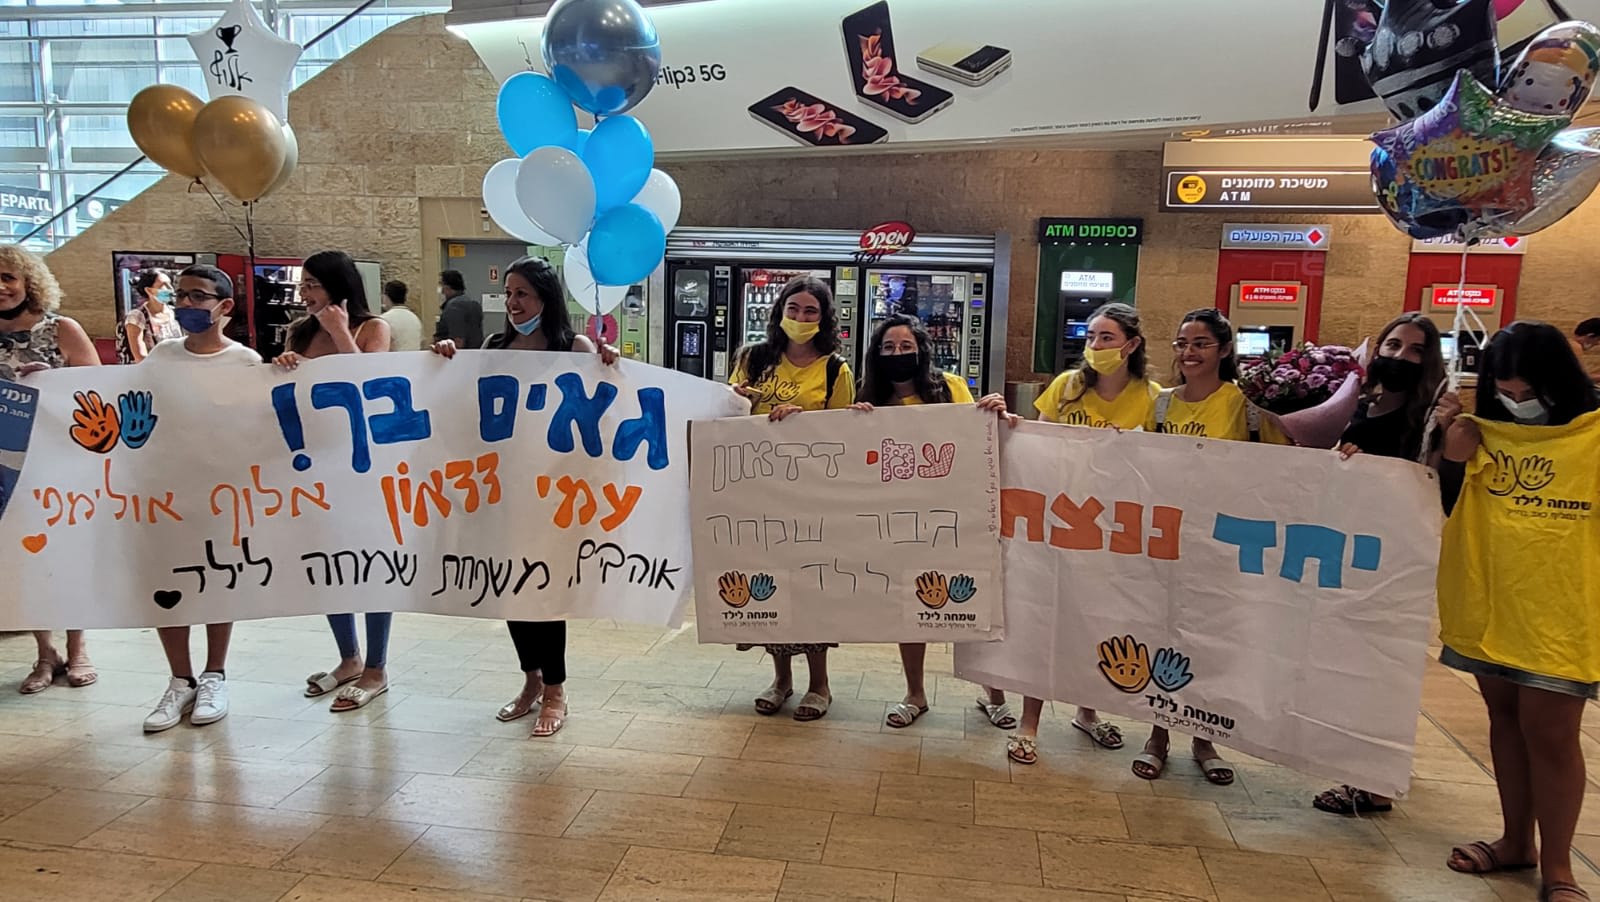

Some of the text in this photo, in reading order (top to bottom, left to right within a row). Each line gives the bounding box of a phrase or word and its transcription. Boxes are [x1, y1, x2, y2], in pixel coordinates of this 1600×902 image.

[699, 63, 726, 81] 5G
[1414, 147, 1510, 181] CONGRATS!
[1220, 177, 1328, 190] משיכת מזומנים
[1220, 191, 1251, 201] ATM
[1045, 224, 1137, 238] כספומט ATM
[1231, 230, 1304, 243] בנק הפועלים
[1, 388, 33, 404] עמי
[270, 371, 668, 473] גאים בך!
[713, 438, 956, 492] עמי דדאון
[33, 457, 184, 527] אולימפי
[209, 464, 332, 547] אלוף
[536, 474, 643, 532] עמי
[1512, 494, 1592, 511] שמחה לילד
[705, 510, 958, 551] גיבור שמחה
[999, 487, 1382, 589] יחד ננצח
[172, 536, 272, 594] לילד
[301, 550, 418, 586] שמחה
[432, 554, 551, 607] משפחת
[800, 557, 890, 594] ללד
[721, 610, 778, 620] שמחה לילד
[917, 611, 976, 621] שמחה לילד
[1145, 694, 1235, 730] שמחה לילד
[1192, 722, 1215, 736] נחליף
[1216, 729, 1232, 740] יחד
